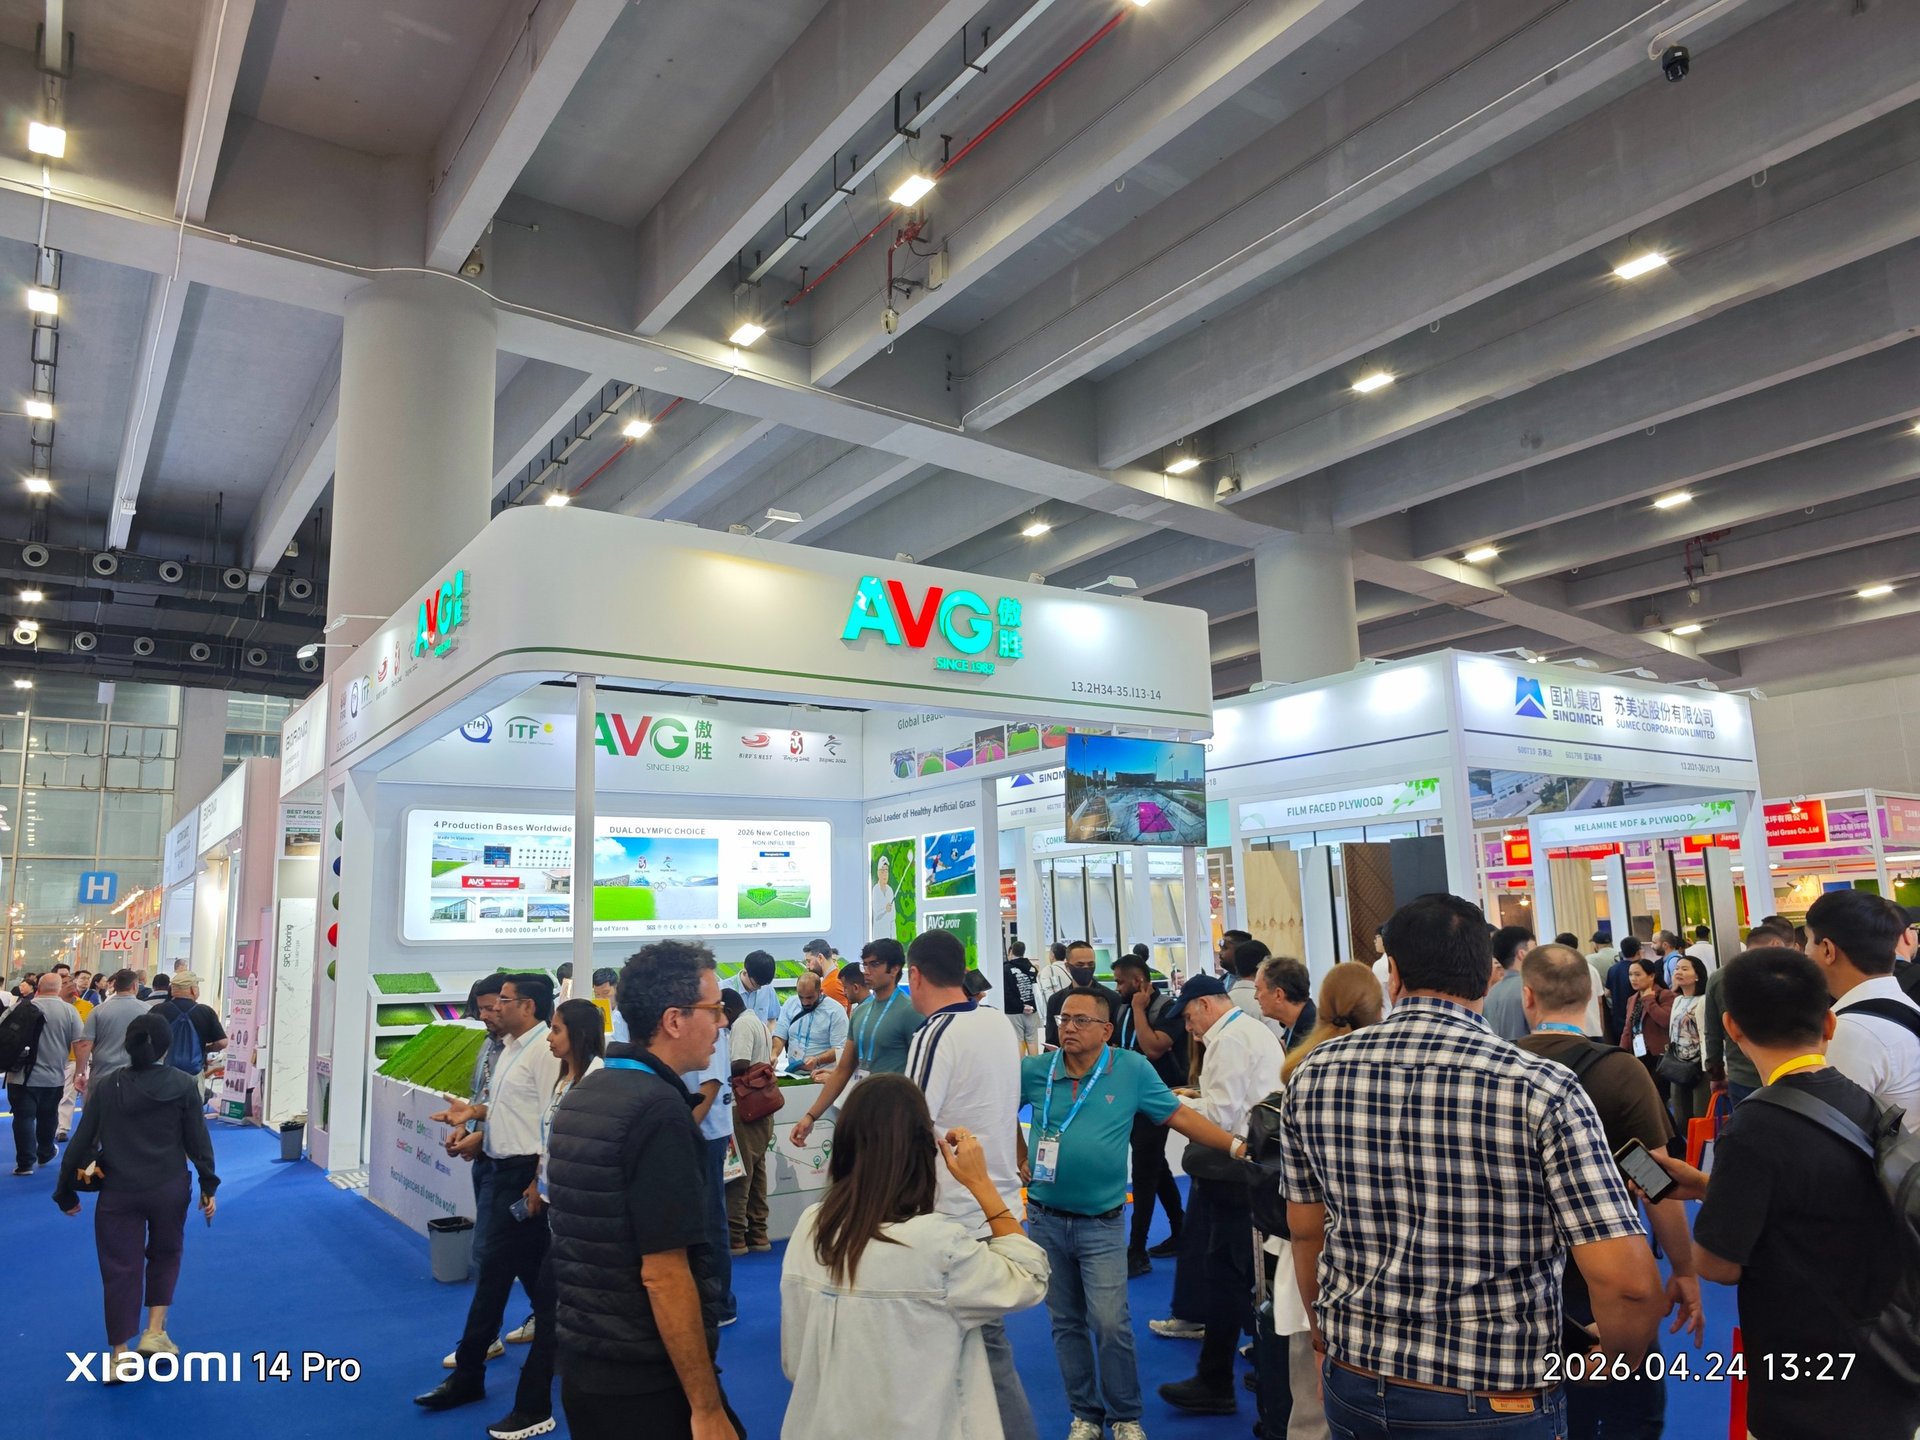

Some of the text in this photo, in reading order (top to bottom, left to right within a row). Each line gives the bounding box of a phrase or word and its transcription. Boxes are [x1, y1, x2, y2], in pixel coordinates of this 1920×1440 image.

[414, 579, 454, 657] AVG
[840, 575, 994, 654] AVG
[997, 596, 1023, 659] 傲胜
[936, 656, 996, 676] SINCE 1982
[1550, 685, 1602, 712] 国机集团
[1552, 709, 1604, 726] SINOMACH
[1613, 695, 1714, 728] 苏美达股份有限公司
[508, 723, 540, 740] ITF
[897, 714, 920, 730] Global
[1616, 719, 1716, 740] SUMEC CORPORATION LIMITED
[694, 719, 713, 760] 傲胜
[646, 763, 690, 772] SINCE 1982
[865, 799, 976, 825] Global Leader of Healthy Artificial Grass
[1286, 796, 1384, 817] FILM FACED PLYWOOD
[433, 820, 573, 832] 4 Production Bases Worldwide
[609, 825, 706, 836] DUAL OLYMPIC CHOICE
[1574, 813, 1694, 832] MELAMINE MDF & PLYWOOD
[1780, 827, 1798, 837] Grass
[773, 829, 810, 837] Collection
[86, 876, 111, 900] H
[927, 915, 961, 930] AVG SPORT
[108, 929, 142, 942] PVC
[283, 924, 295, 968] SPC Flooring
